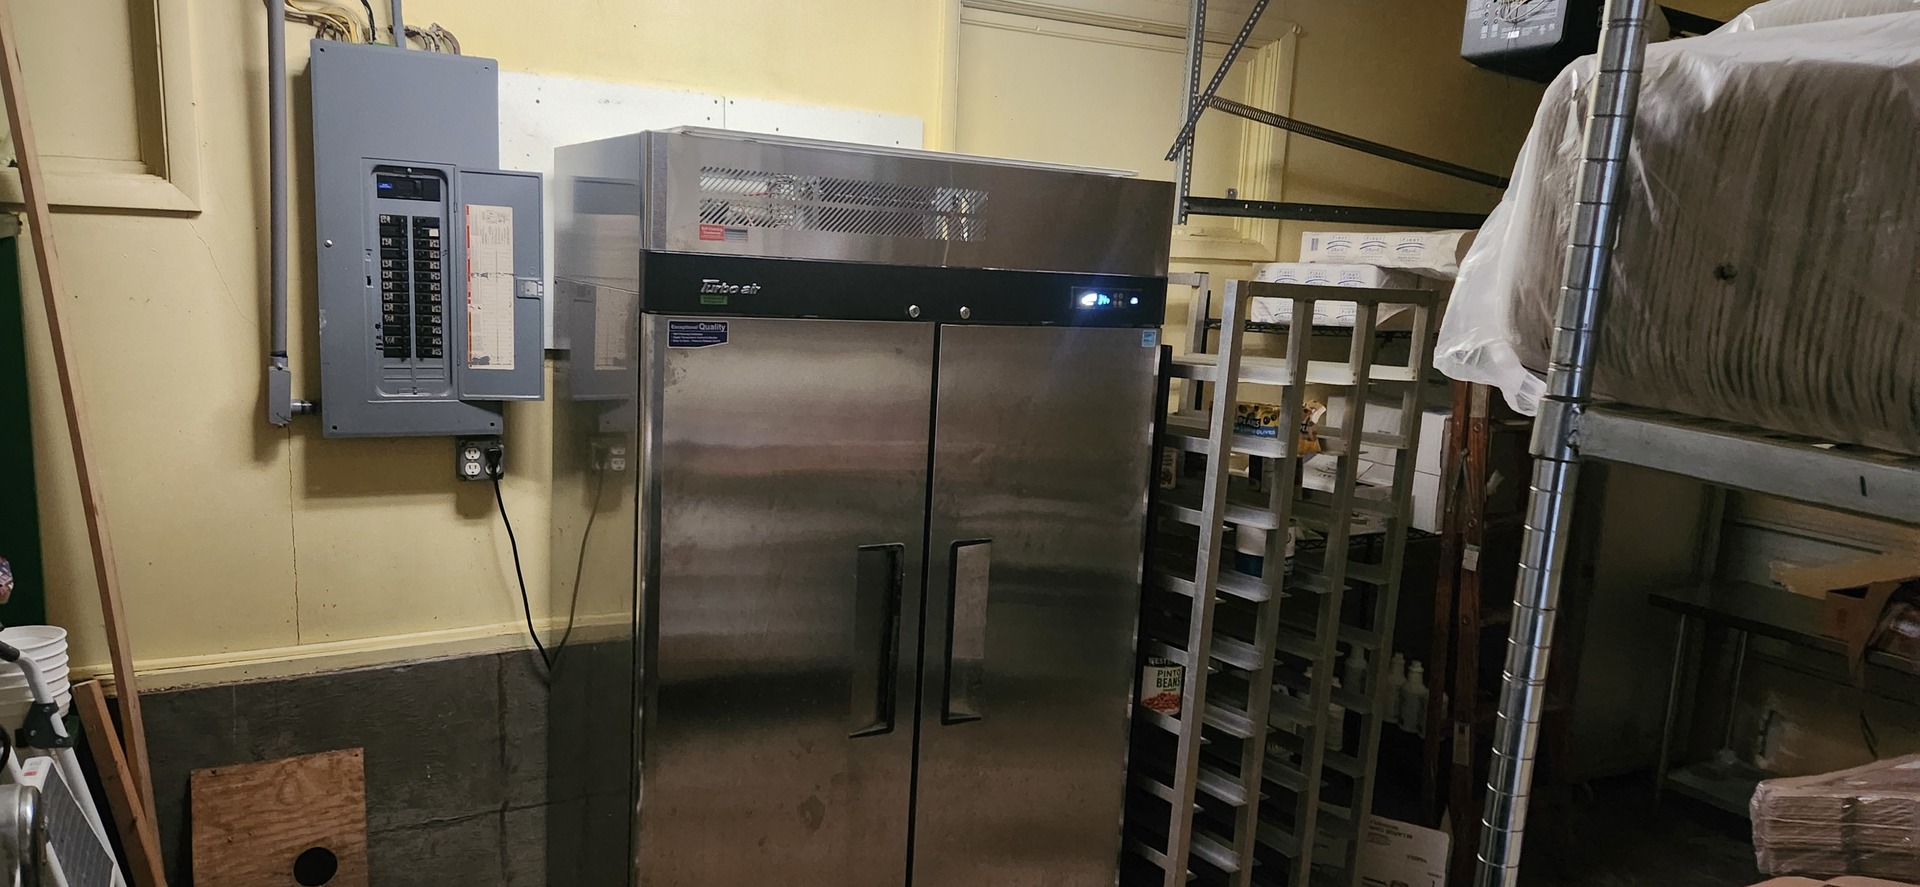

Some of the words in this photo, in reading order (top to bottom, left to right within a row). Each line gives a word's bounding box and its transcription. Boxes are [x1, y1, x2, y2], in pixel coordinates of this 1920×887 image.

[700, 278, 739, 293] Turbo
[740, 282, 761, 295] air
[698, 322, 726, 332] Quality
[1157, 669, 1181, 677] PINTO
[1156, 676, 1180, 688] BEANS
